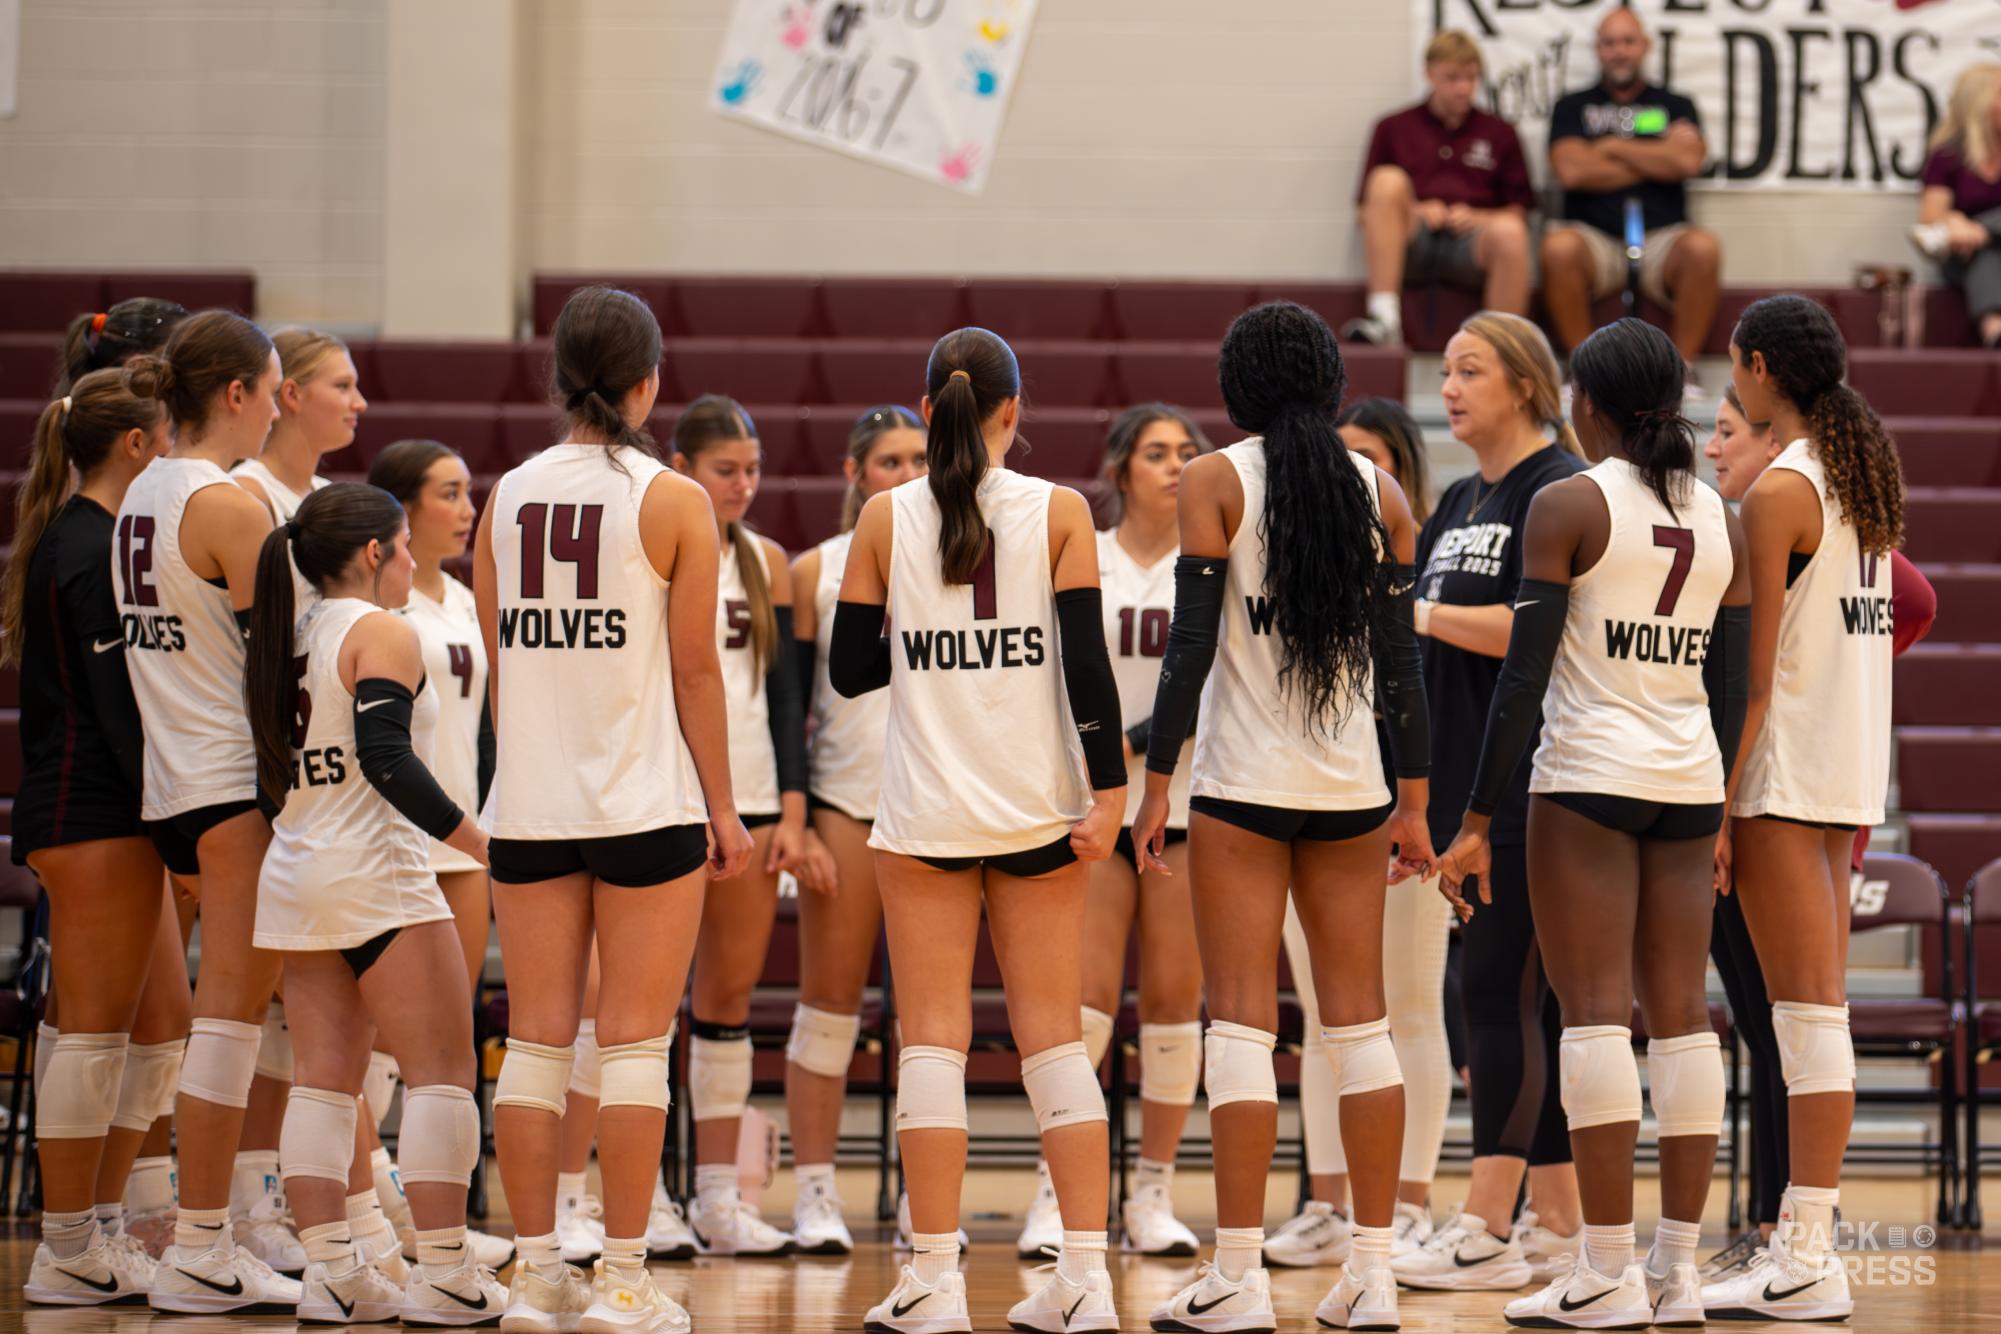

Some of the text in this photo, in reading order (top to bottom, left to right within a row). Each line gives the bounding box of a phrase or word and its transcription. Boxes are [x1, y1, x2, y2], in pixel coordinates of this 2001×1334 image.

[118, 515, 159, 607] 12
[516, 502, 604, 600] 14
[1461, 556, 1502, 577] 2025
[1652, 524, 1695, 616] 7
[122, 613, 186, 651] OLVES
[499, 608, 627, 649] WOLVES
[724, 600, 752, 649] 5
[902, 626, 1045, 671] WOLVES
[1119, 607, 1170, 657] 10
[1605, 618, 1711, 666] WOLVES
[447, 644, 473, 698] 4
